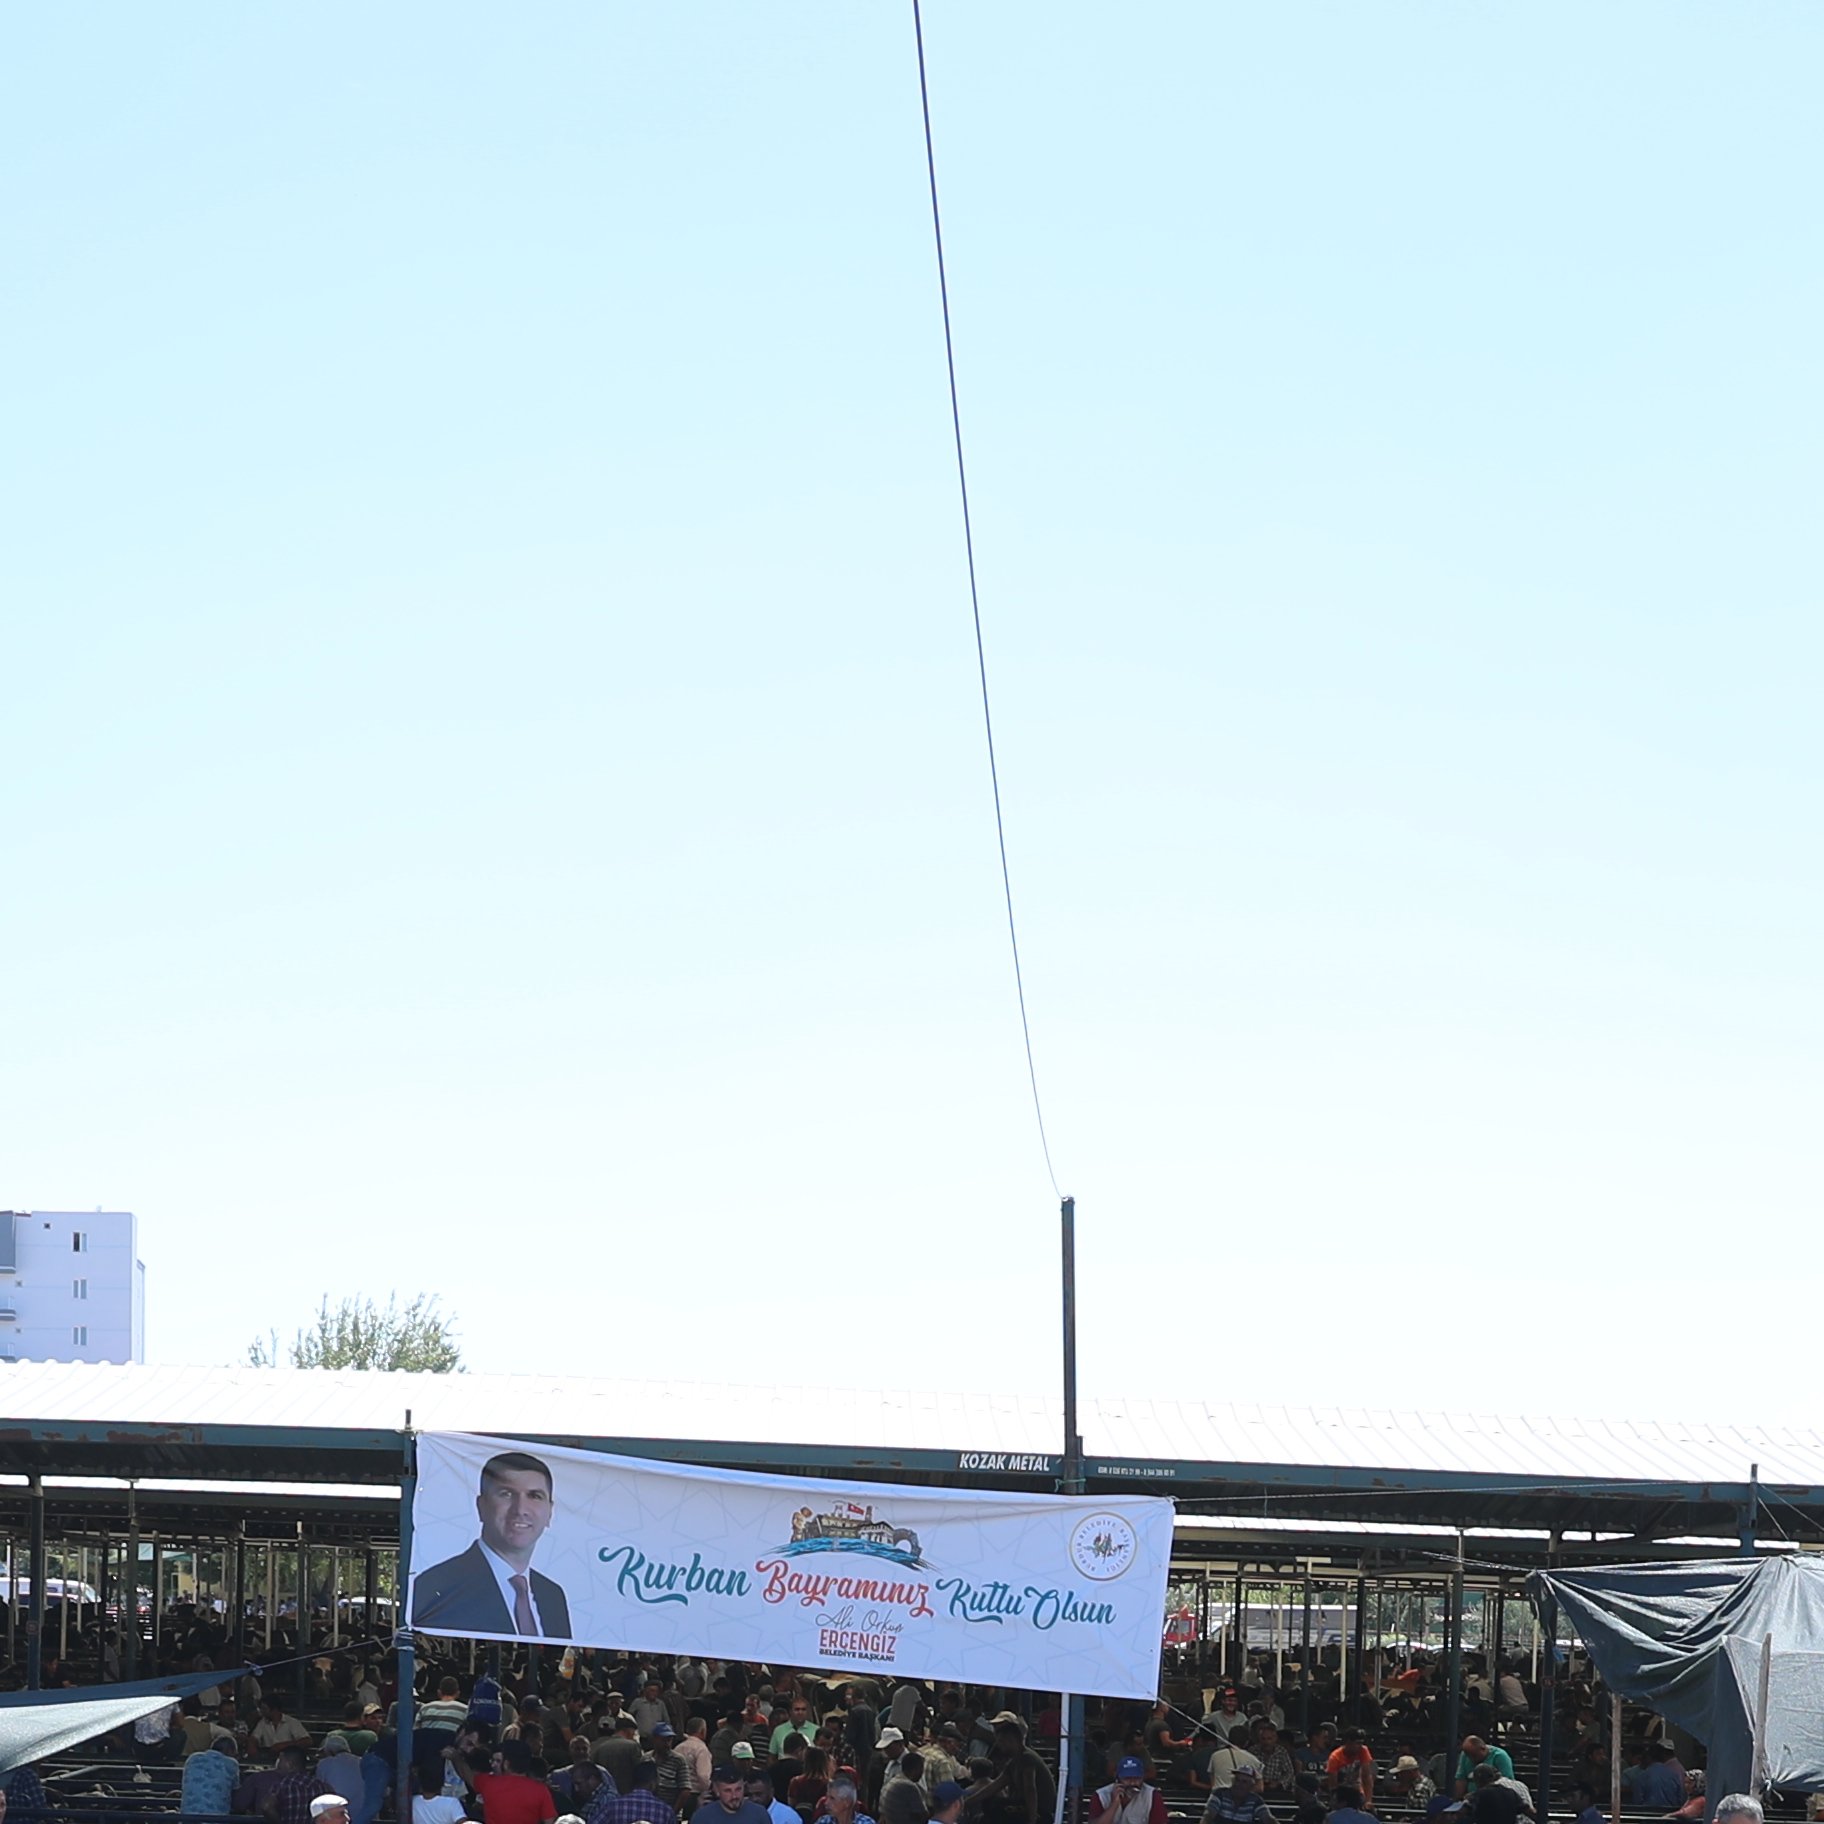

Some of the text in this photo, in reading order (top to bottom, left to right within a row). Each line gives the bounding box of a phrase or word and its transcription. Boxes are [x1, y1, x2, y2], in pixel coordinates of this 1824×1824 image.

[959, 1453, 1051, 1472] KOZAK METAL
[598, 1546, 1117, 1630] Kurban Bayramınız Kutlu Olsun
[815, 1604, 854, 1630] Ali
[819, 1648, 895, 1662] BELEDİYE BAŞKANI
